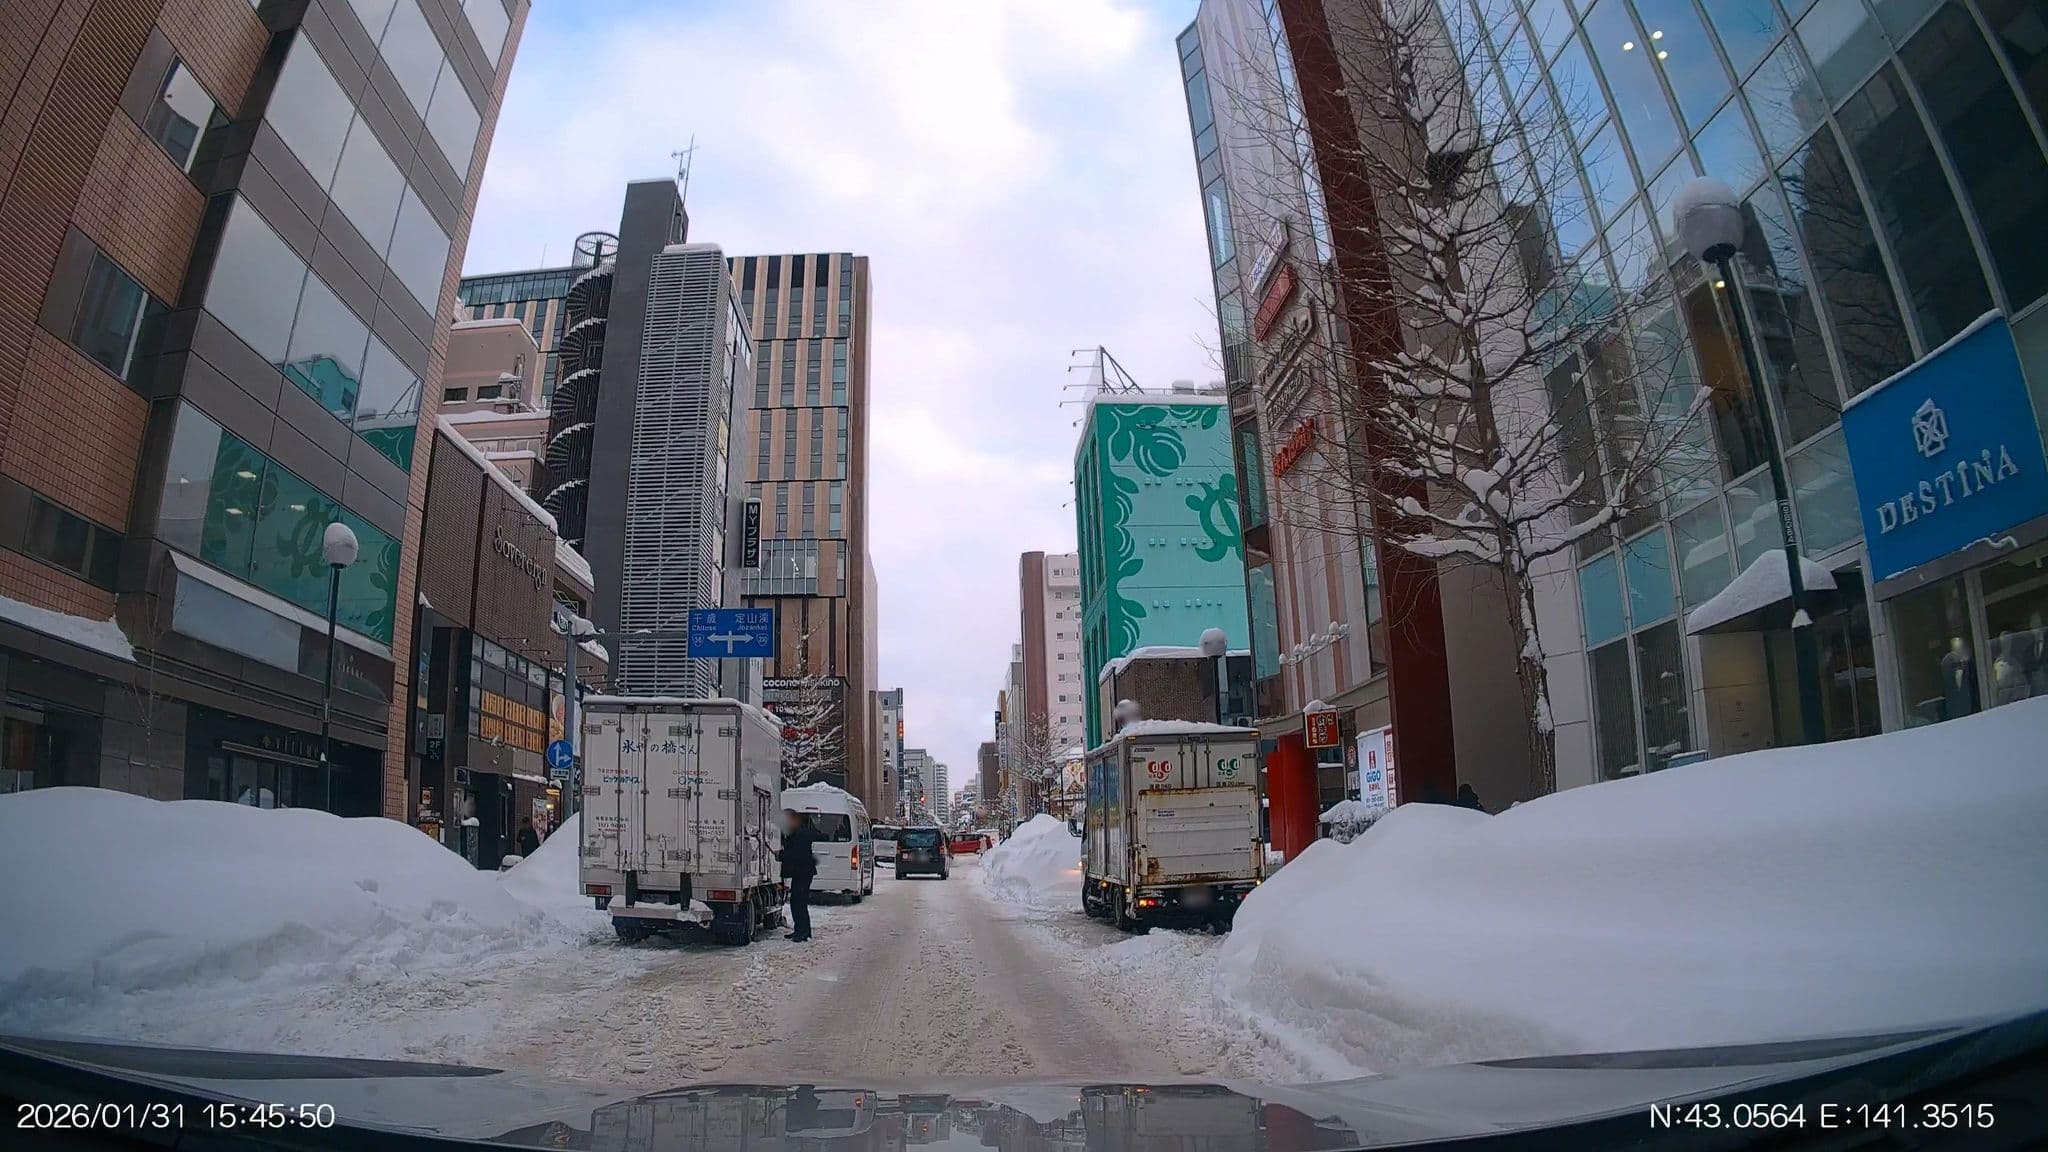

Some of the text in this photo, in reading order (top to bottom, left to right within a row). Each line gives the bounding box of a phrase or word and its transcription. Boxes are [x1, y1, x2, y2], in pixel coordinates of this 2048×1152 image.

[1875, 444, 2020, 535] DESTINA
[494, 525, 547, 590] Sovereign
[692, 613, 717, 624] 千歳
[735, 612, 769, 624] 定山渓
